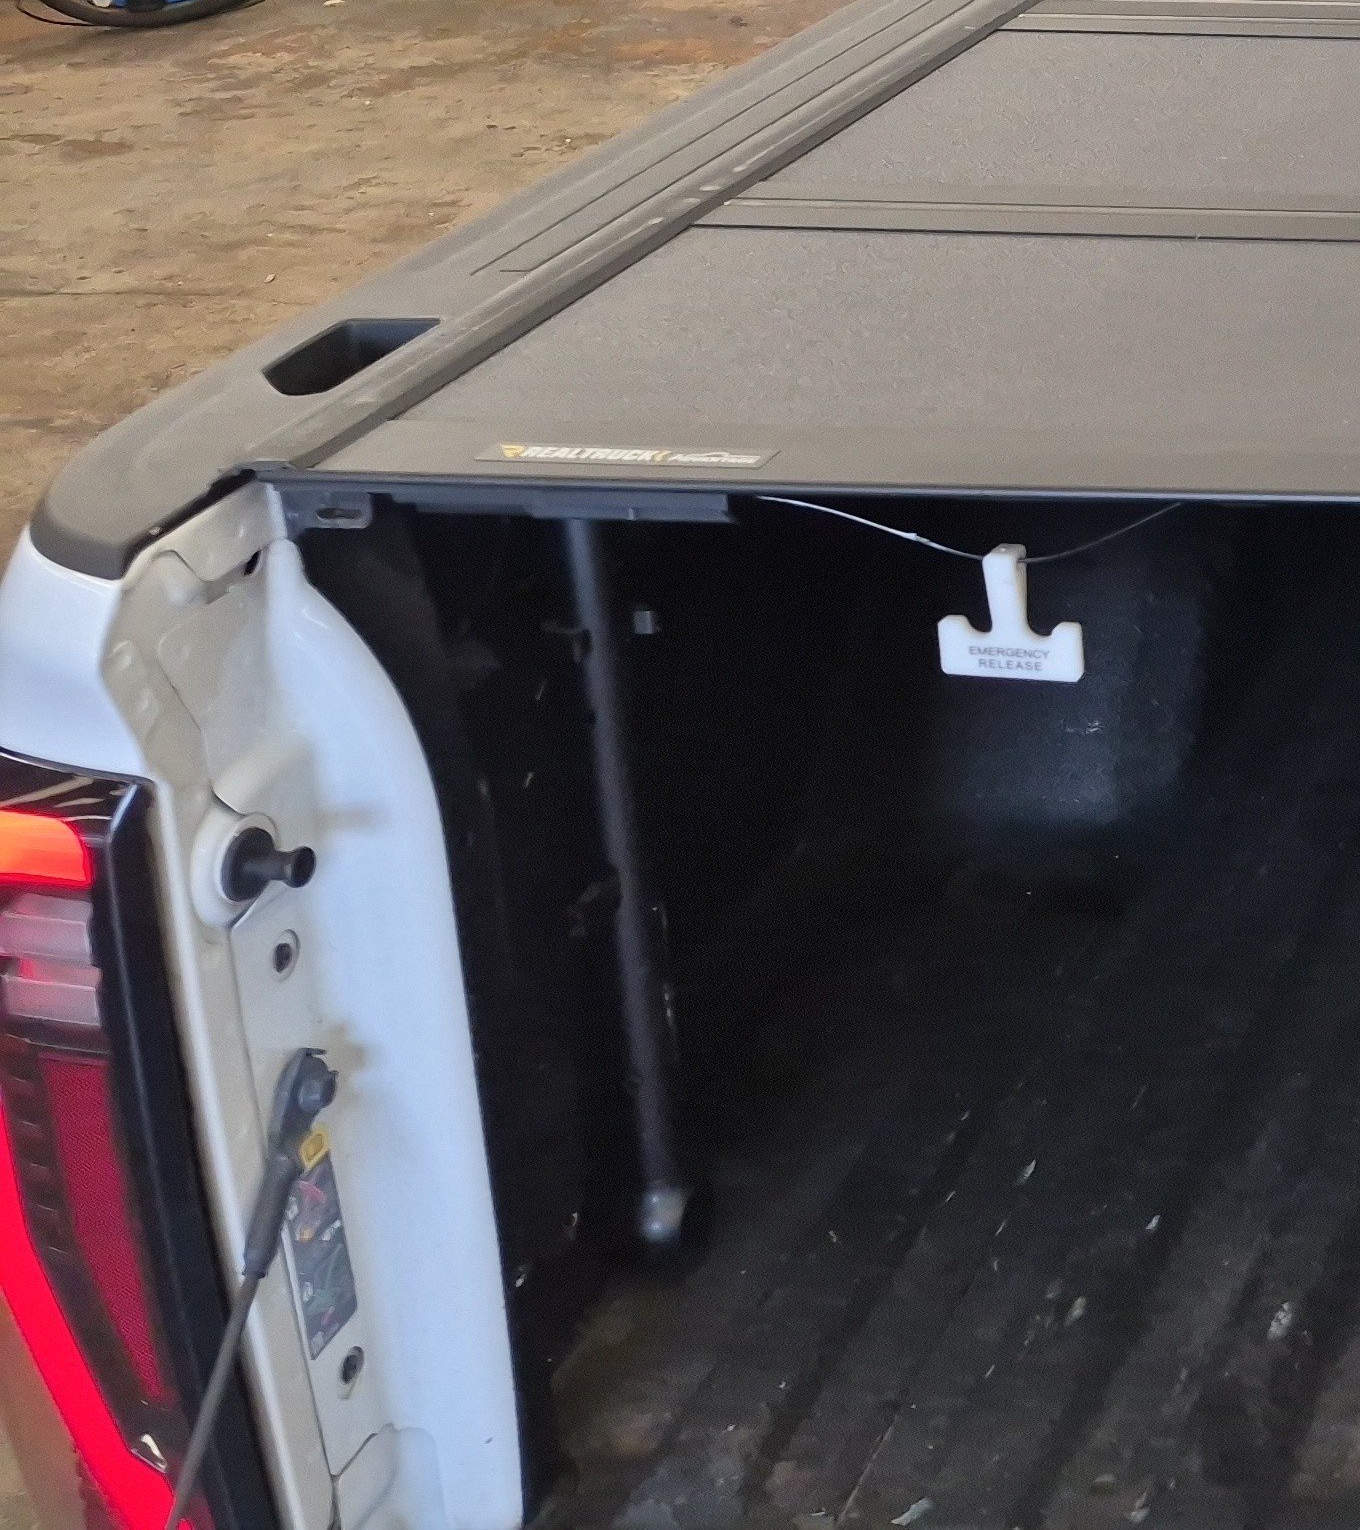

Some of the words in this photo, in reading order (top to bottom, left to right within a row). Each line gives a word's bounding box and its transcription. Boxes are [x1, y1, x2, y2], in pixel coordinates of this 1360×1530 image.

[521, 446, 659, 461] REALTRUCK
[968, 645, 1049, 659] EMERGENCY
[978, 658, 1043, 671] RELEASE
